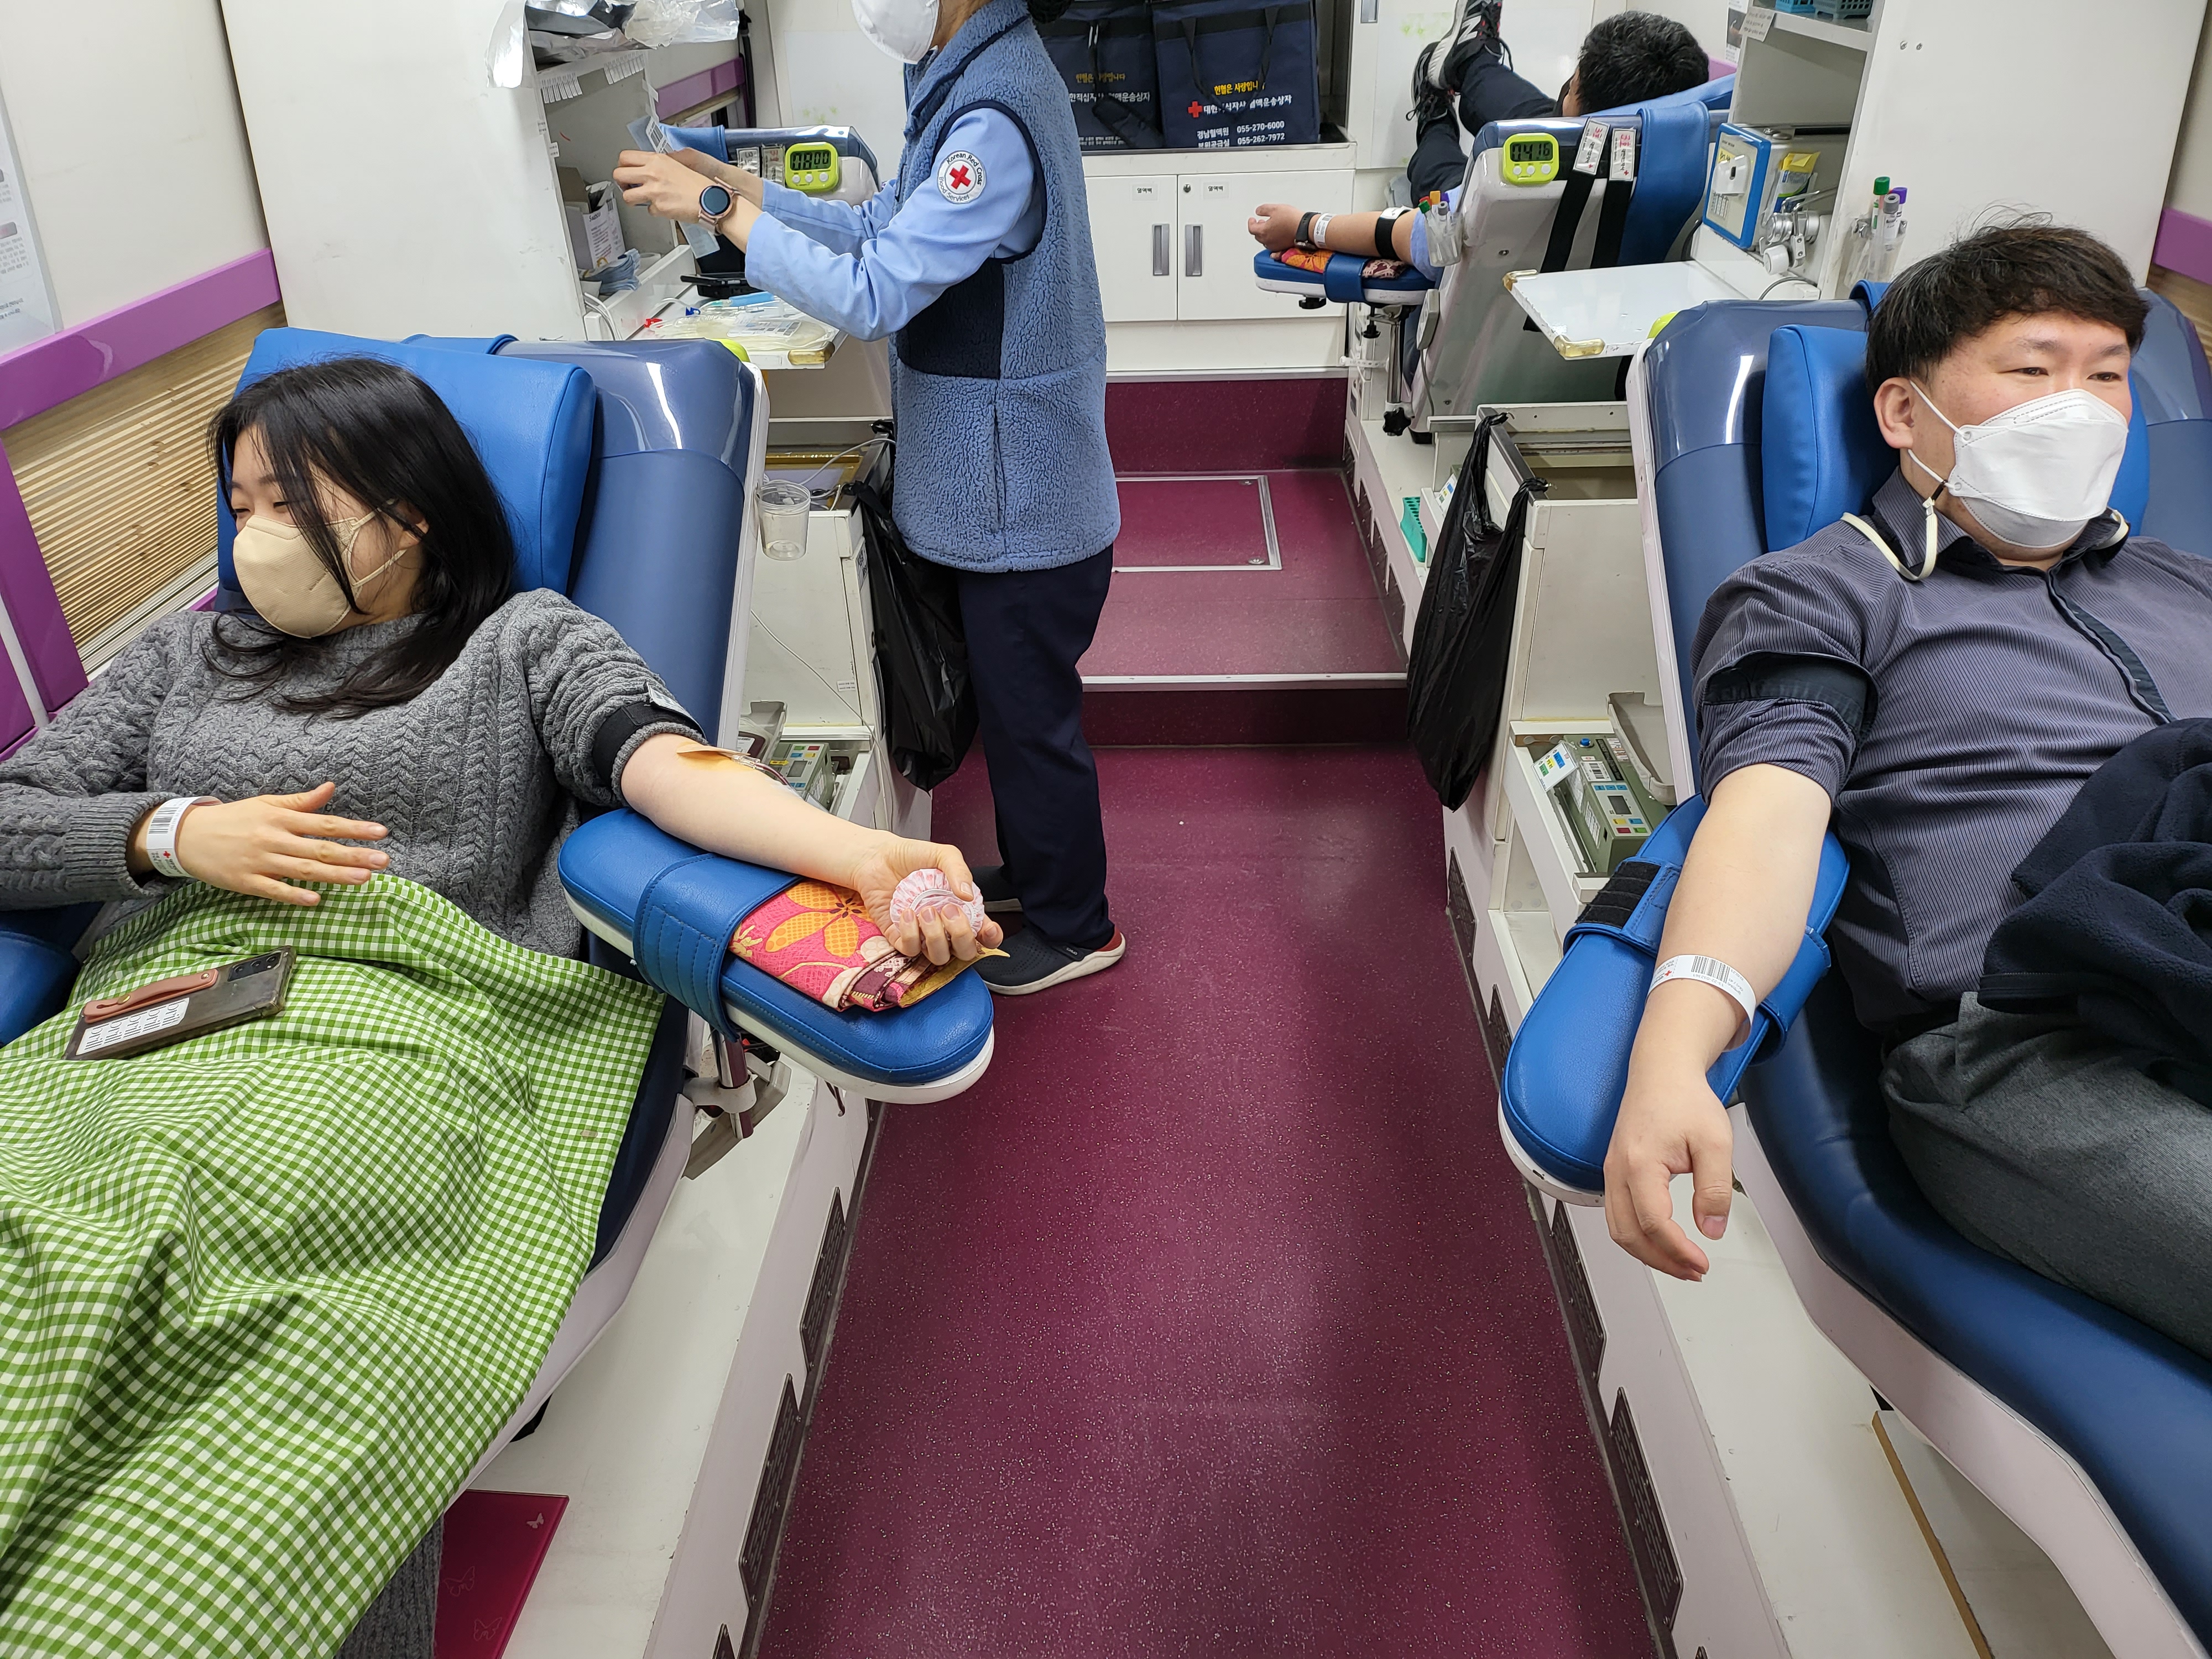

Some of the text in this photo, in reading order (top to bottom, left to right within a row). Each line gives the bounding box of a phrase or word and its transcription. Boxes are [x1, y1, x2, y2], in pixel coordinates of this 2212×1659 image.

[1213, 80, 1265, 96] 헌혈은 사랑입니
[1108, 91, 1150, 102] 액운송상자
[1203, 101, 1247, 115] 대한십자사
[1197, 121, 1285, 140] 경남혈액원 055-270-6000
[1237, 133, 1286, 145] 055-262-7972
[946, 153, 966, 165] Korean
[967, 154, 979, 167] Red
[939, 176, 970, 202] Blood Services
